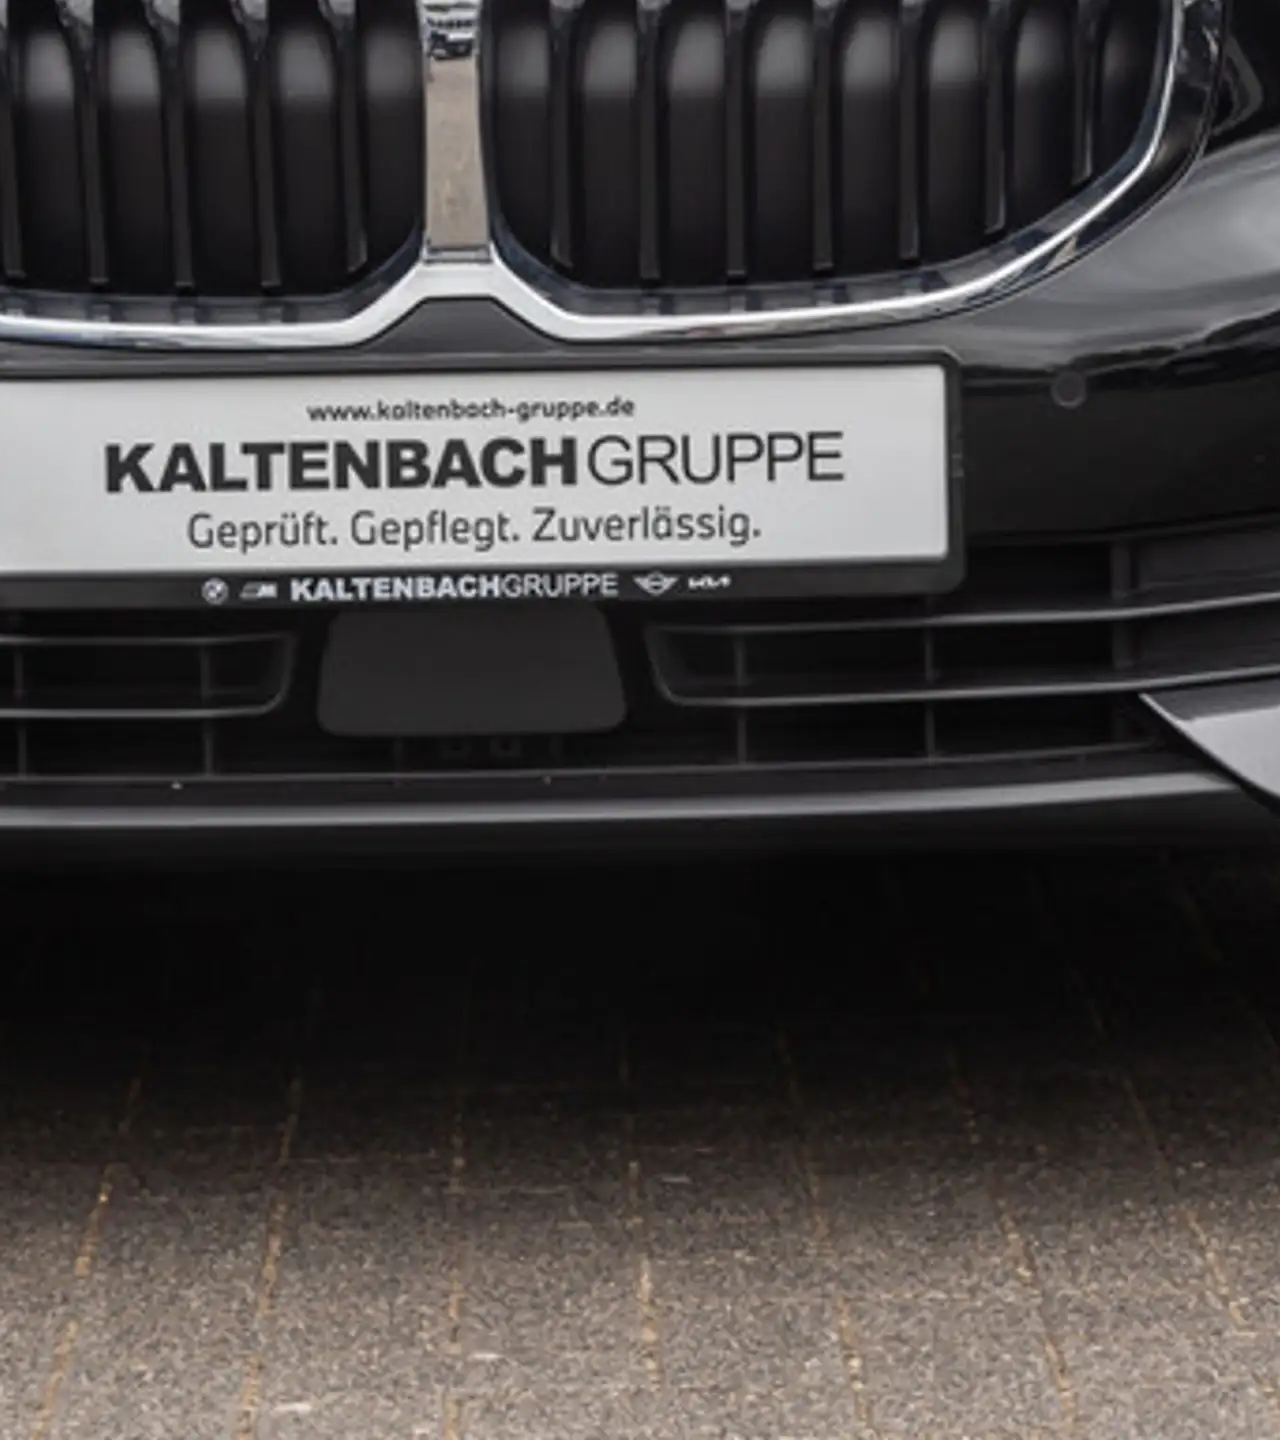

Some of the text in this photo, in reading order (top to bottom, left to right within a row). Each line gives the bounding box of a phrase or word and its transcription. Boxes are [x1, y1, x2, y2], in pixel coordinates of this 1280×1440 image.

[306, 394, 636, 424] www.kaltenbach-gruppe.de
[186, 503, 762, 554] Geprüft. Gepflegt. Zuverlässig.
